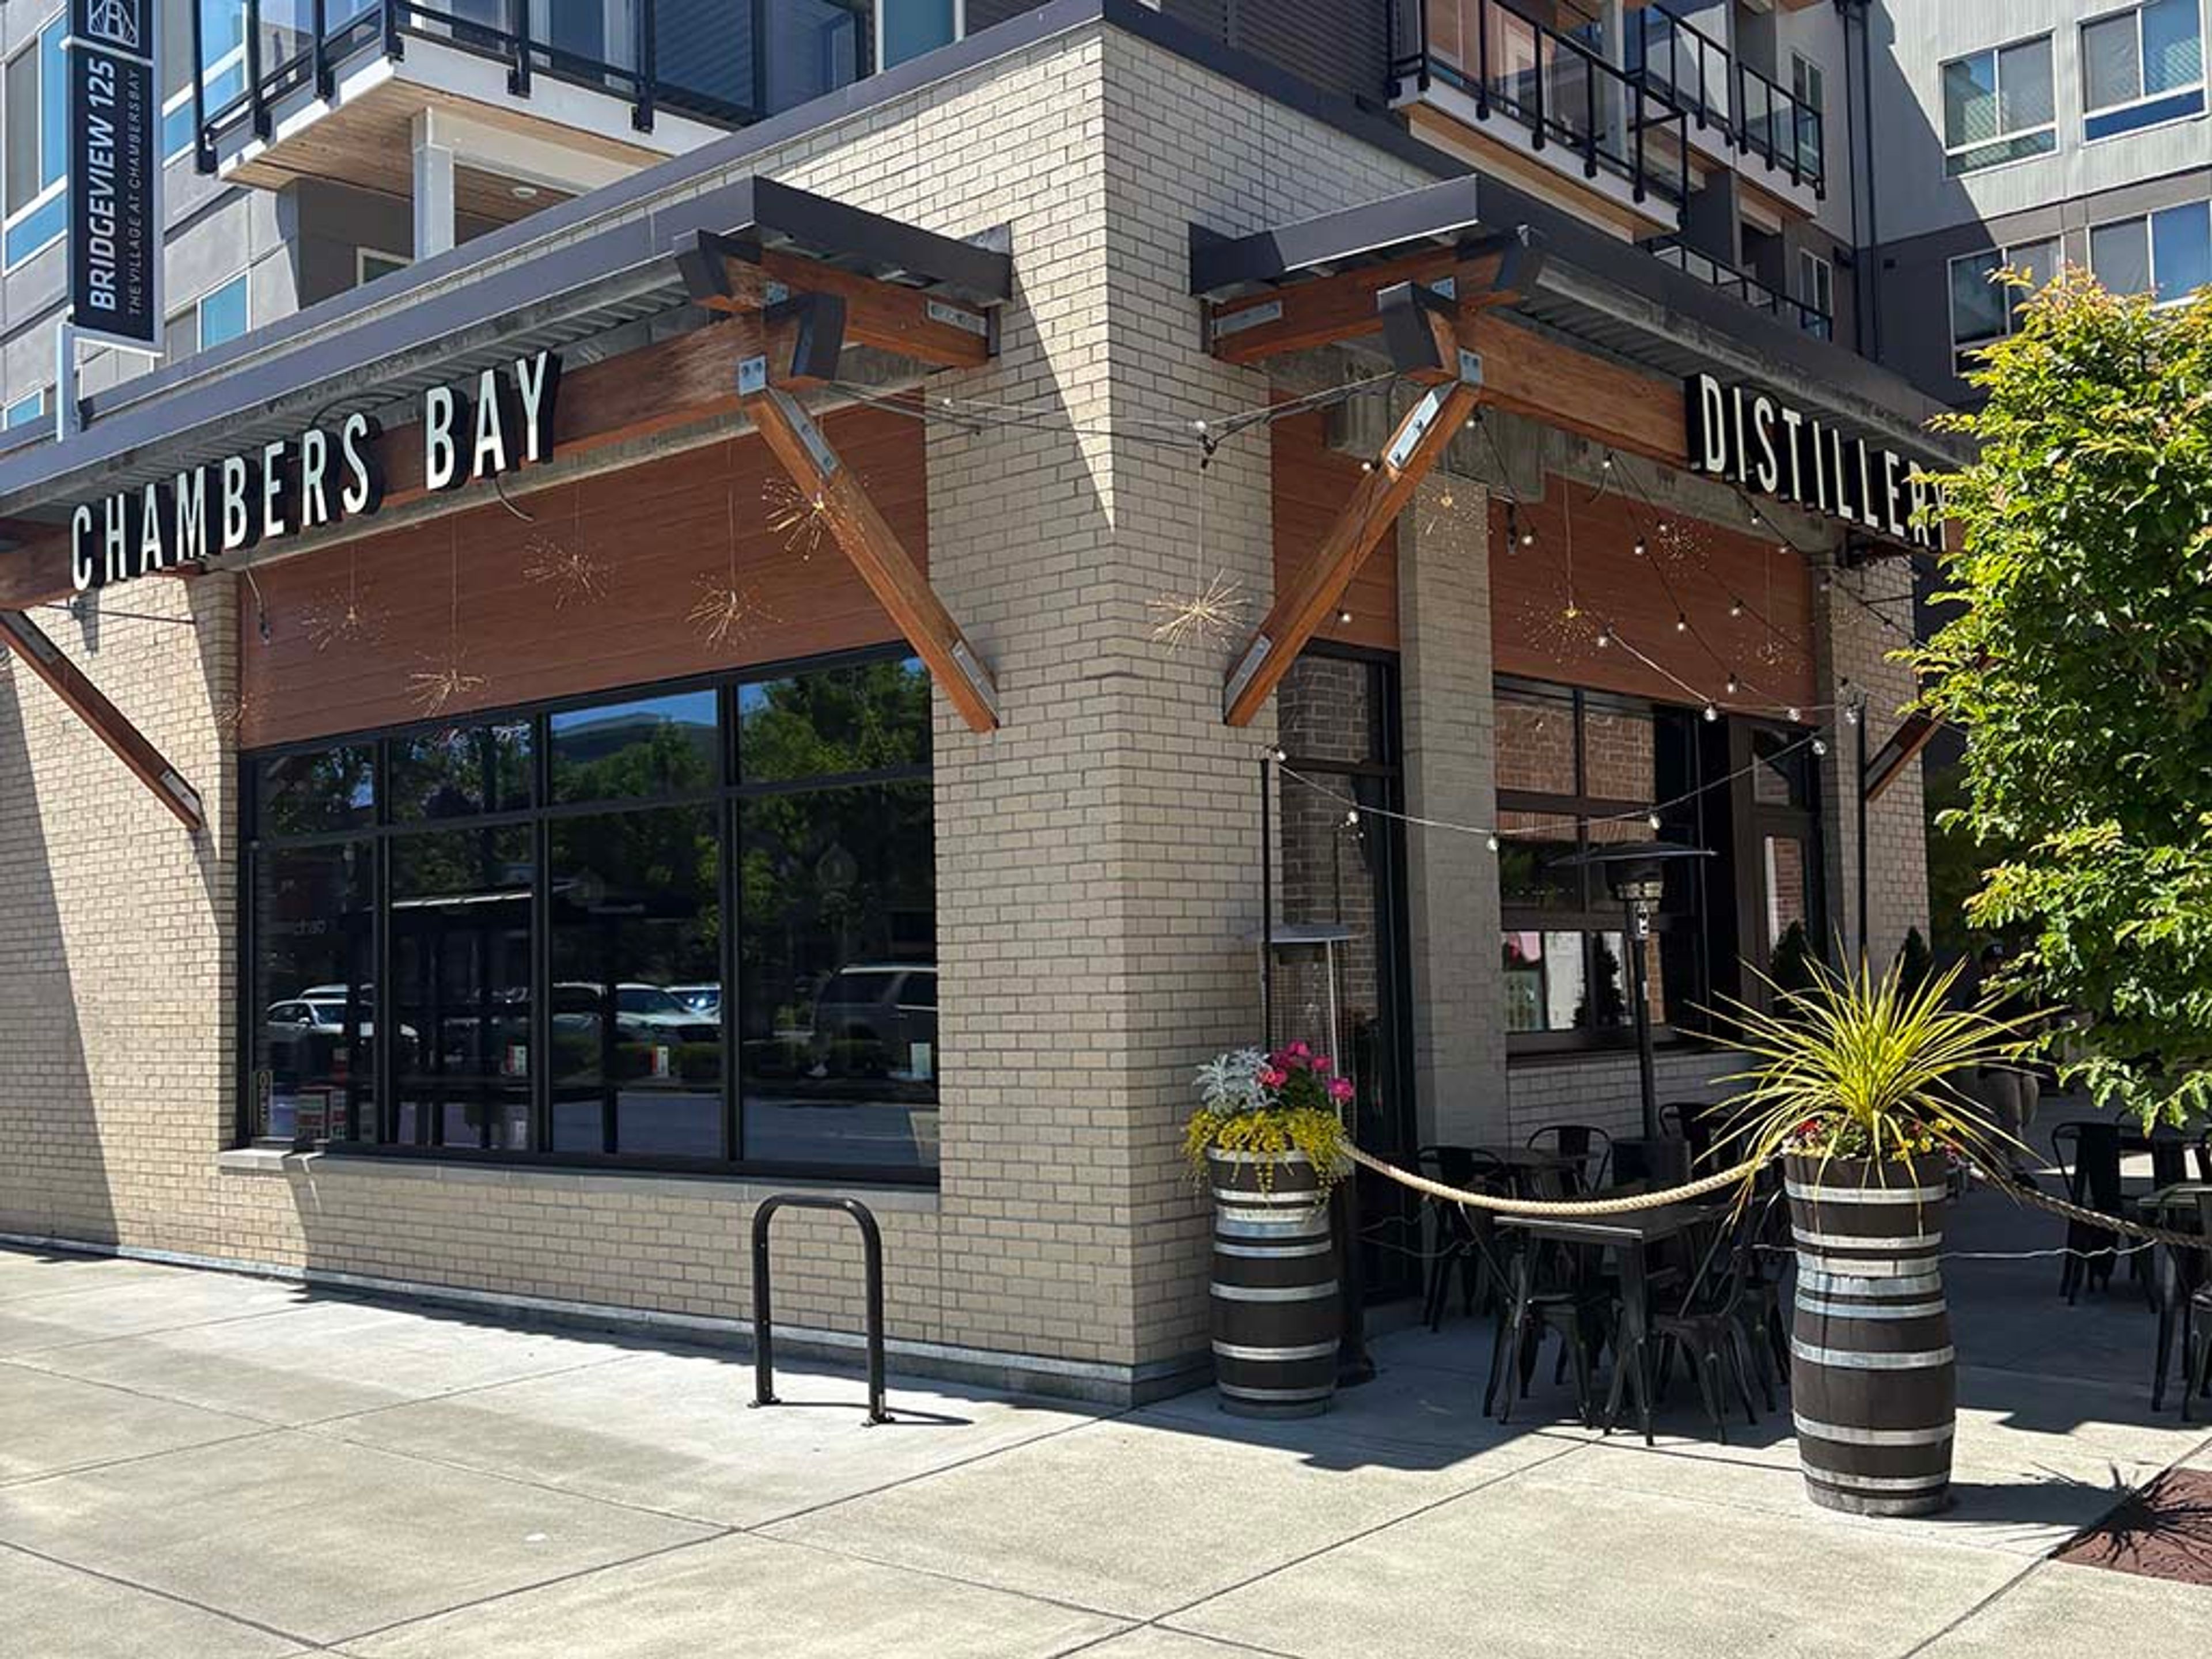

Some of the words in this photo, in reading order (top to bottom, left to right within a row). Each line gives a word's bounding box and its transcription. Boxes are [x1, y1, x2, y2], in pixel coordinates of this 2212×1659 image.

[88, 57, 115, 108] 125
[89, 115, 116, 311] BRIDGEVIEW
[128, 193, 141, 213] AT
[127, 217, 141, 283] VILLAGE
[127, 285, 141, 315] THE
[71, 412, 371, 592] CHAMBERS
[425, 350, 550, 491] BAY
